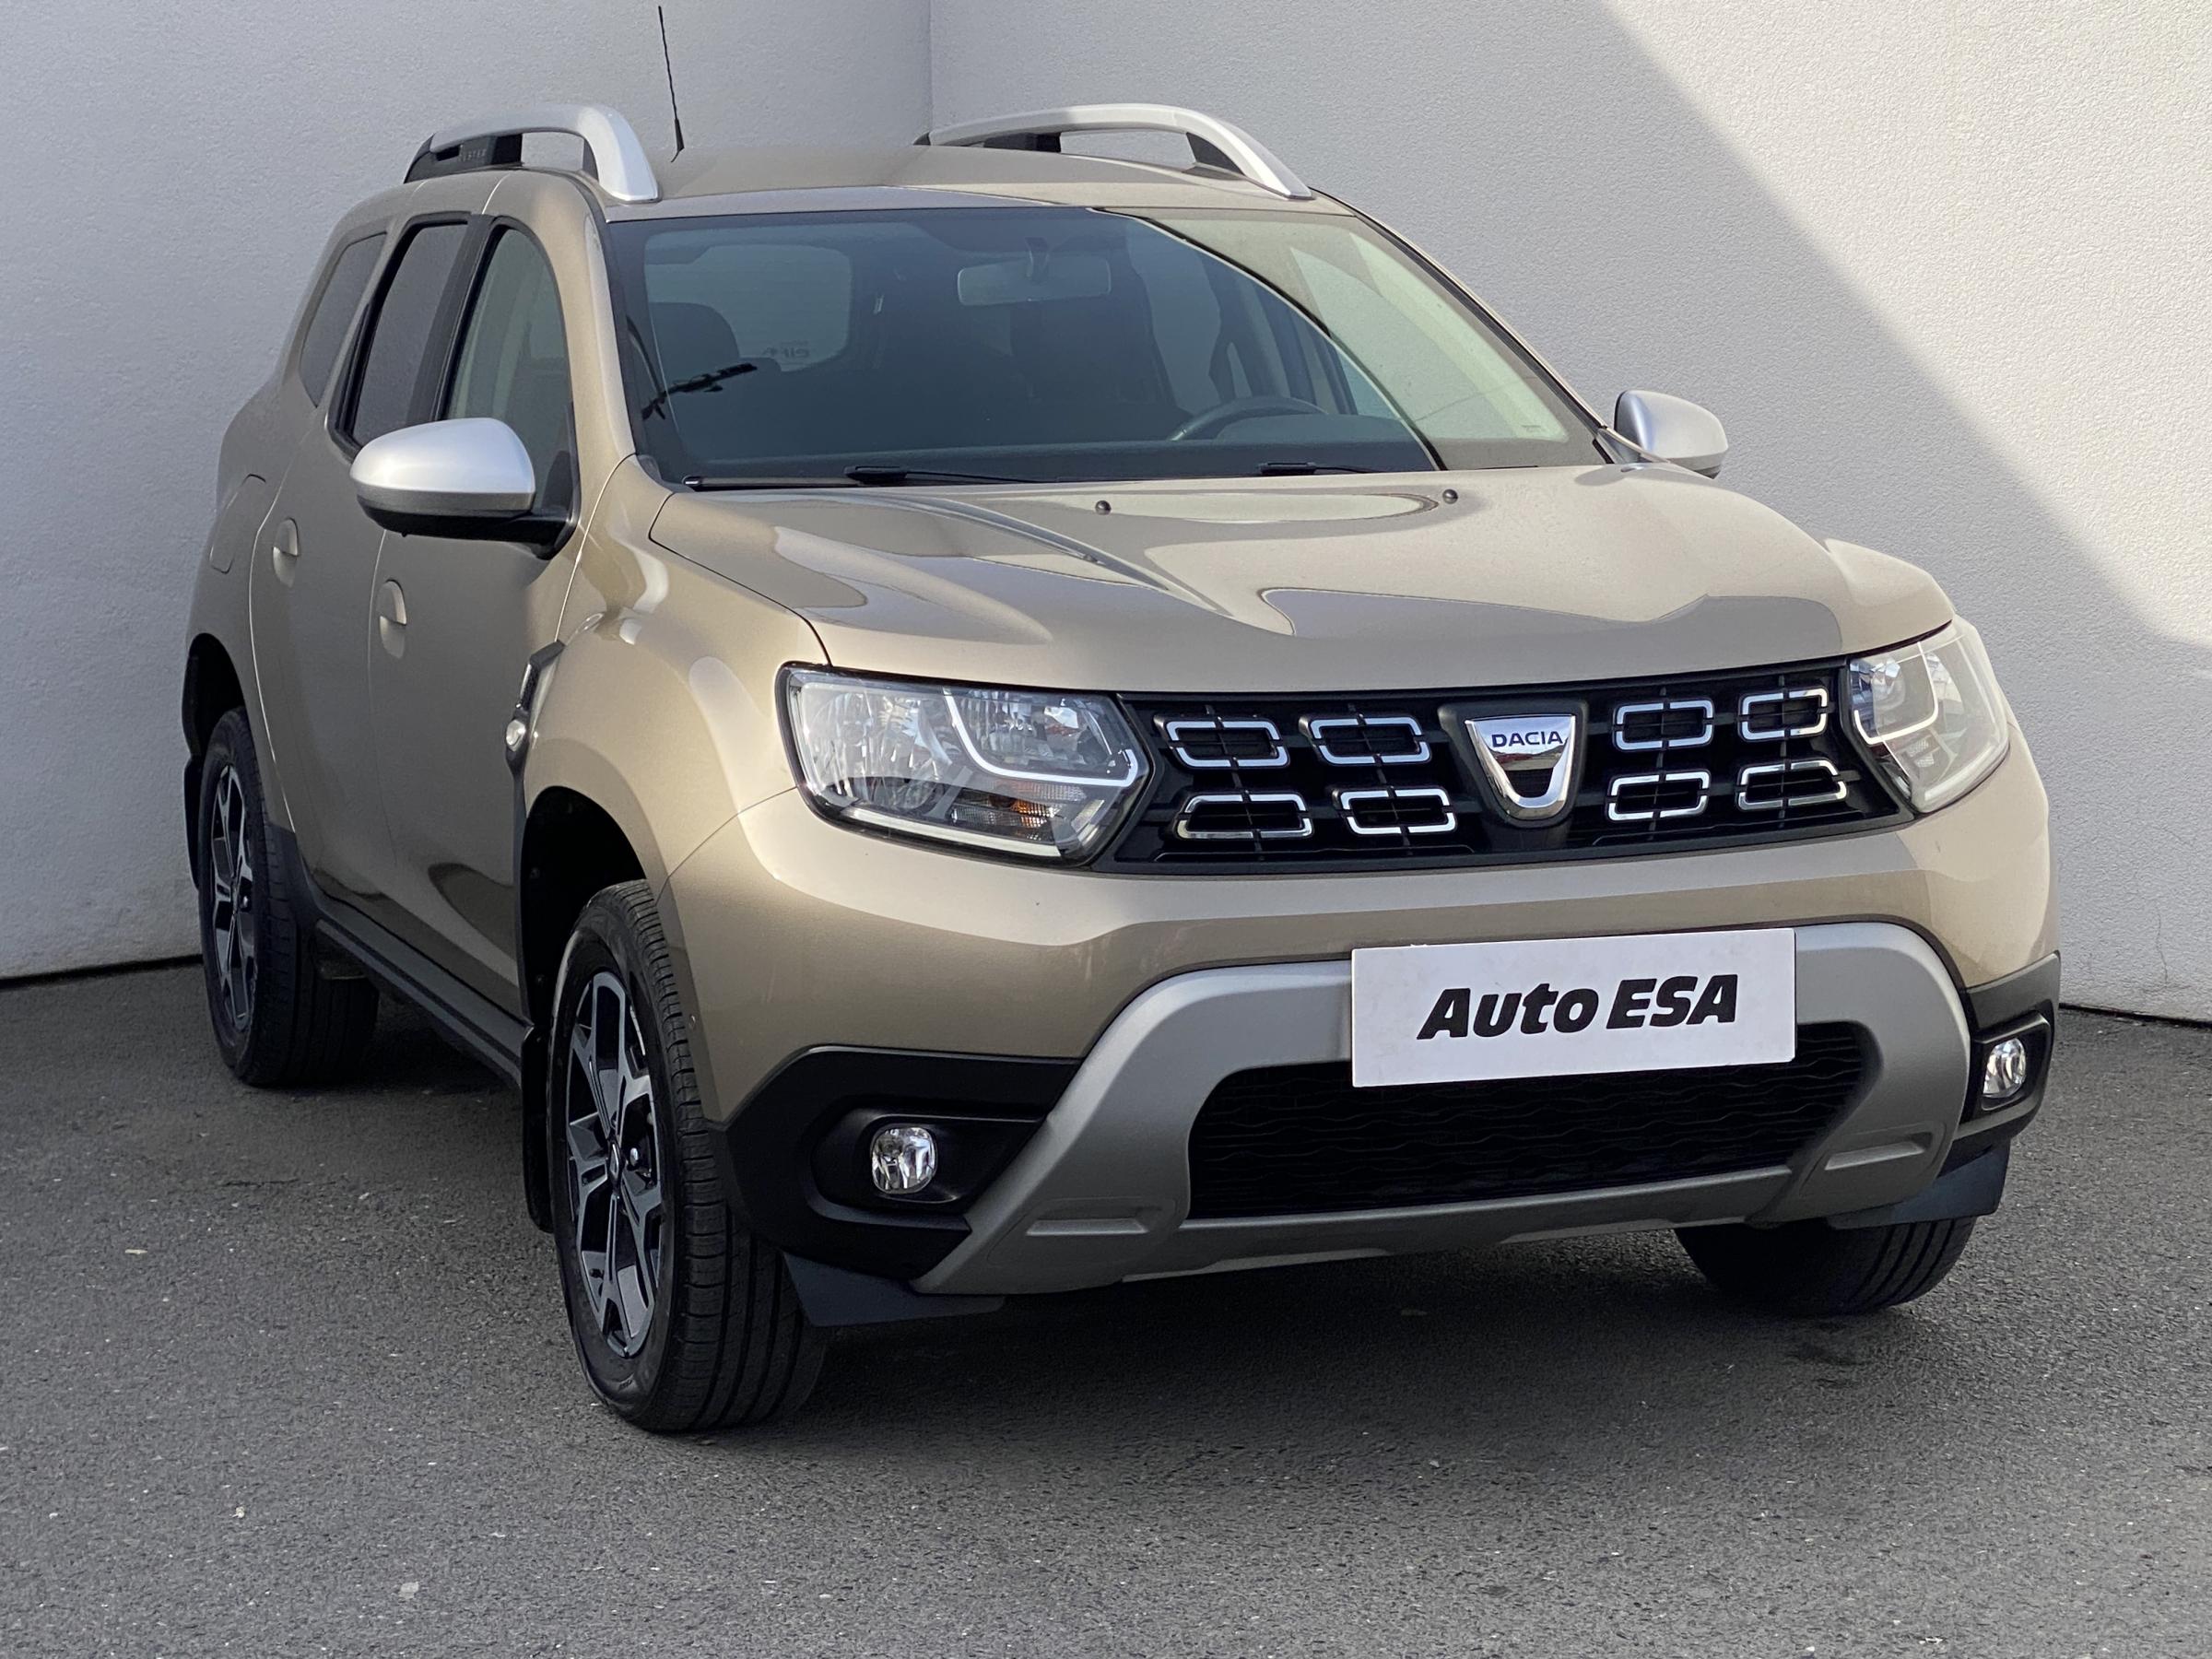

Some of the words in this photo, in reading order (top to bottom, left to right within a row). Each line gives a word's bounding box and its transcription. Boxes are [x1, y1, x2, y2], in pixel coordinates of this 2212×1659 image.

[1491, 731, 1563, 747] DACIA
[1417, 983, 1599, 1040] Auto
[1606, 974, 1738, 1030] ESA
